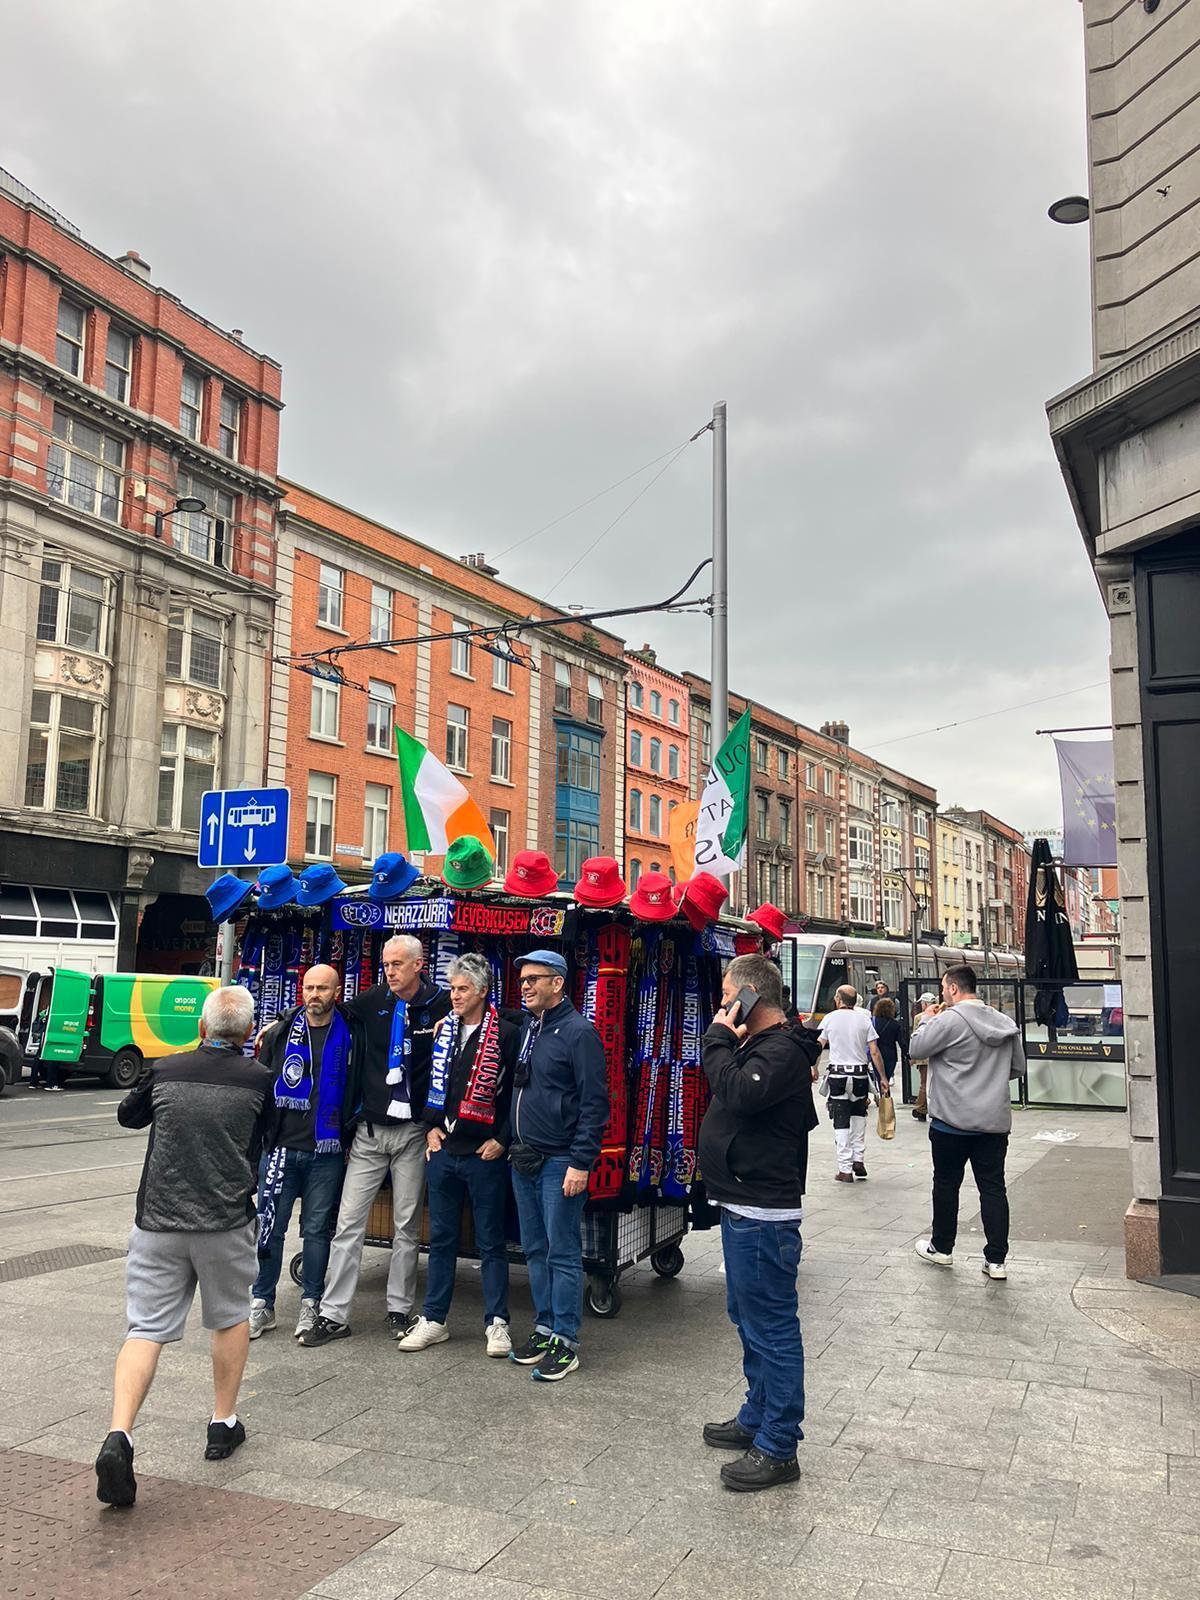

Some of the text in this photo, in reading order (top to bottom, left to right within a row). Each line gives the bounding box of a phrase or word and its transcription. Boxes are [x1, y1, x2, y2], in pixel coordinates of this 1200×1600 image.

[384, 904, 449, 924] NERAZZURRI
[455, 906, 530, 931] LEVERKUSEN
[262, 975, 280, 1028] NERAZZU
[478, 1011, 492, 1043] DUBLIN
